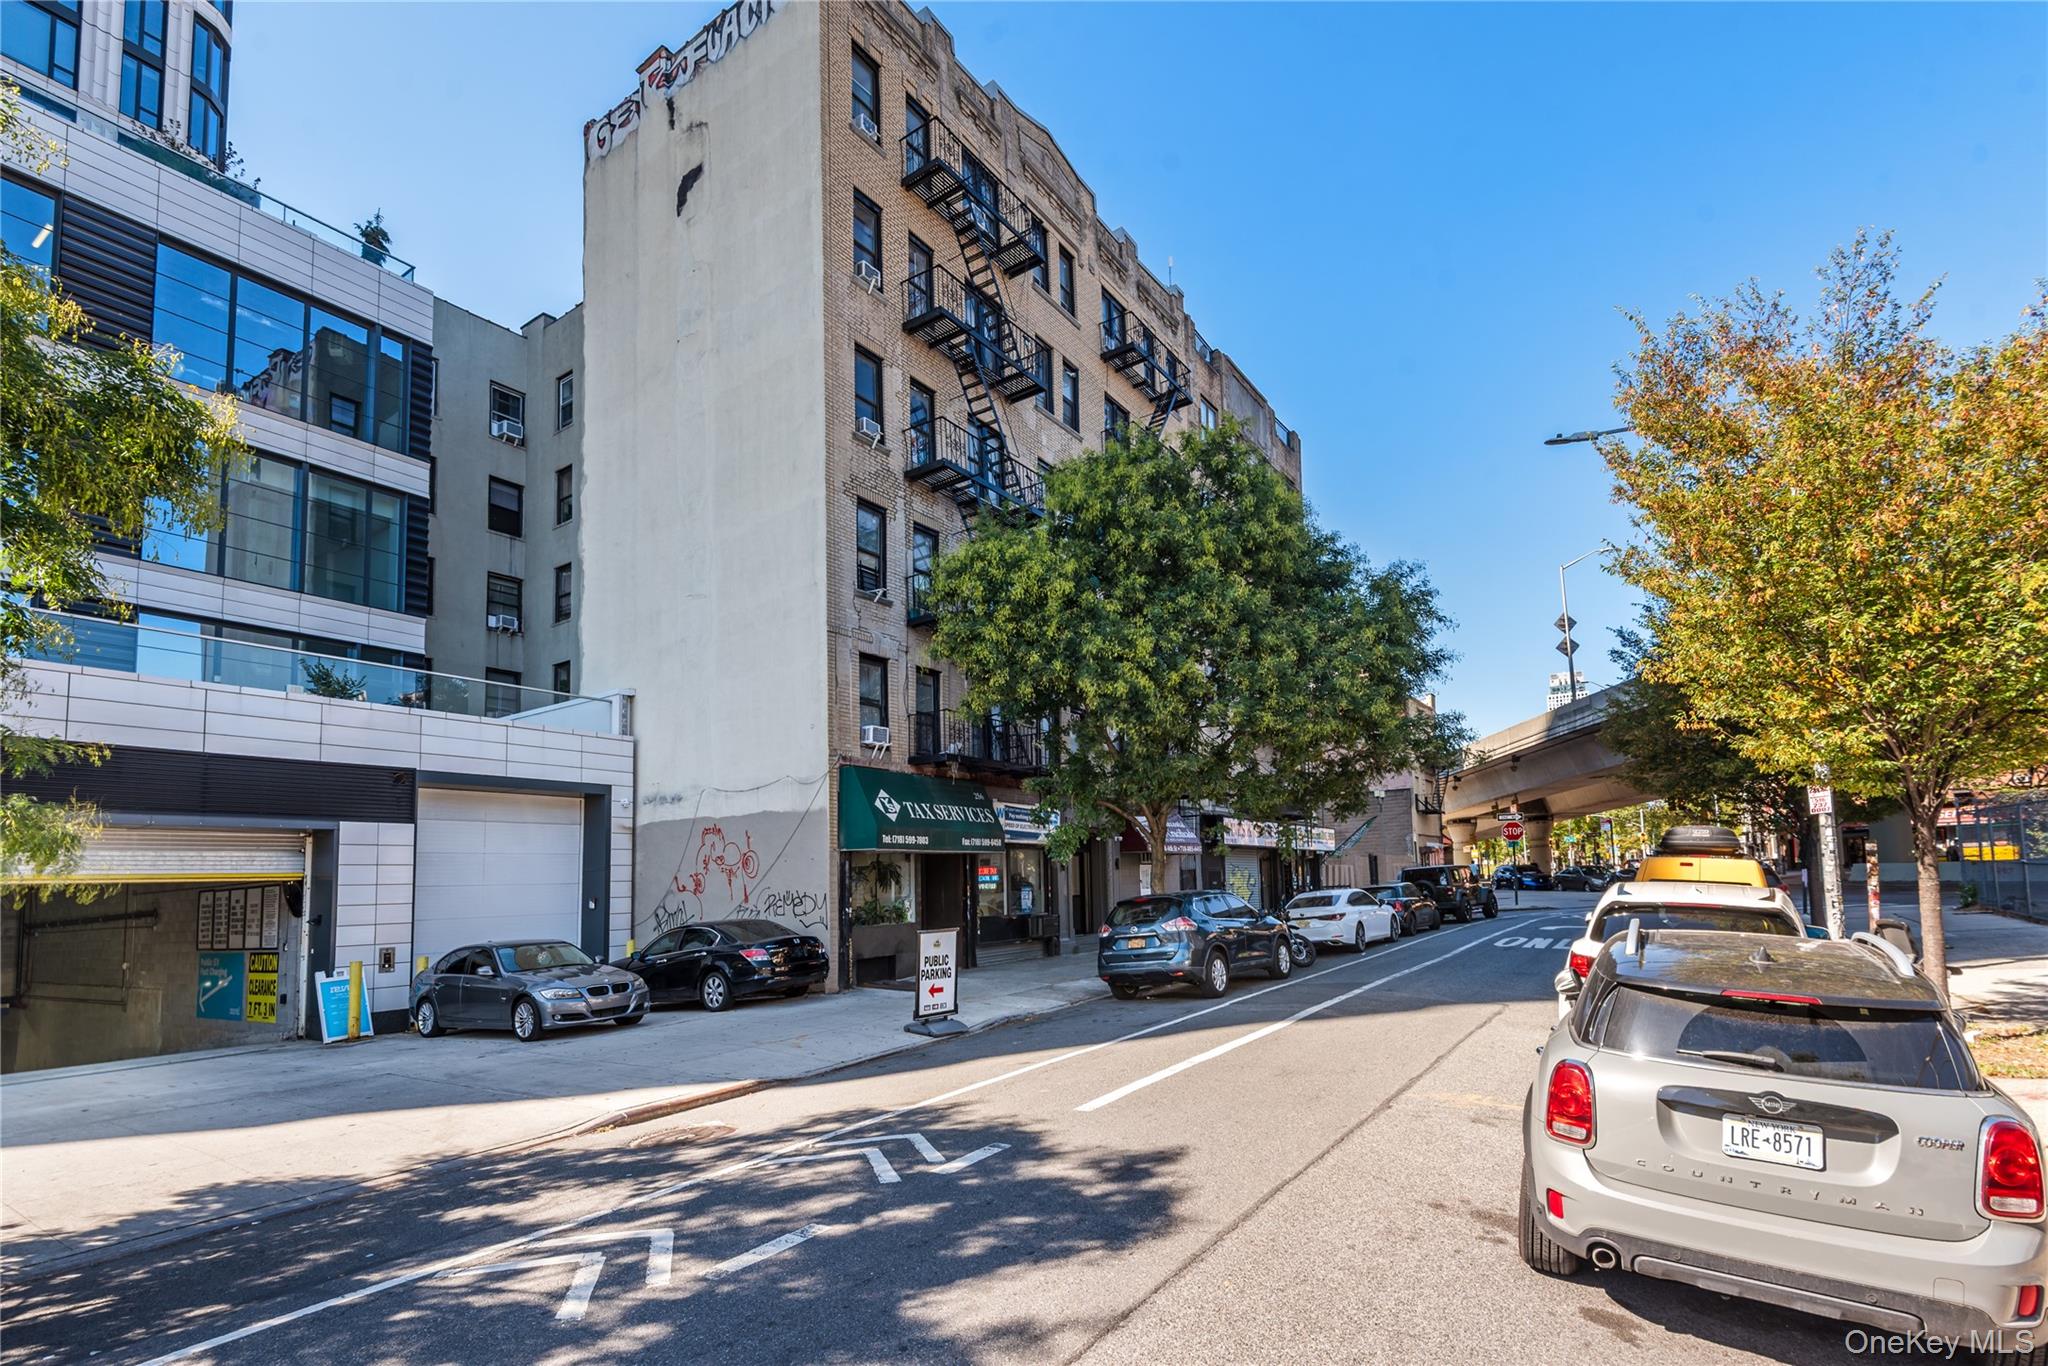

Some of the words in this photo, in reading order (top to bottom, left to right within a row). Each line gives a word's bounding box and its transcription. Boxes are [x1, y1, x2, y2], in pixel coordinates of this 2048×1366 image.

[902, 801, 935, 820] TAX
[933, 804, 995, 824] SERVICES
[1503, 827, 1523, 836] STOP
[1493, 936, 1572, 950] ONL
[250, 954, 278, 971] CAUTION
[924, 954, 949, 968] PUBLIC
[921, 966, 952, 981] PARKING
[249, 979, 277, 996] CLEARANCE
[269, 1002, 275, 1017] IN
[1747, 1119, 1770, 1129] NEW
[1770, 1121, 1797, 1132] YORK
[1917, 1136, 1965, 1151] COOPER
[1637, 1159, 1924, 1216] COUNTRYMAN
